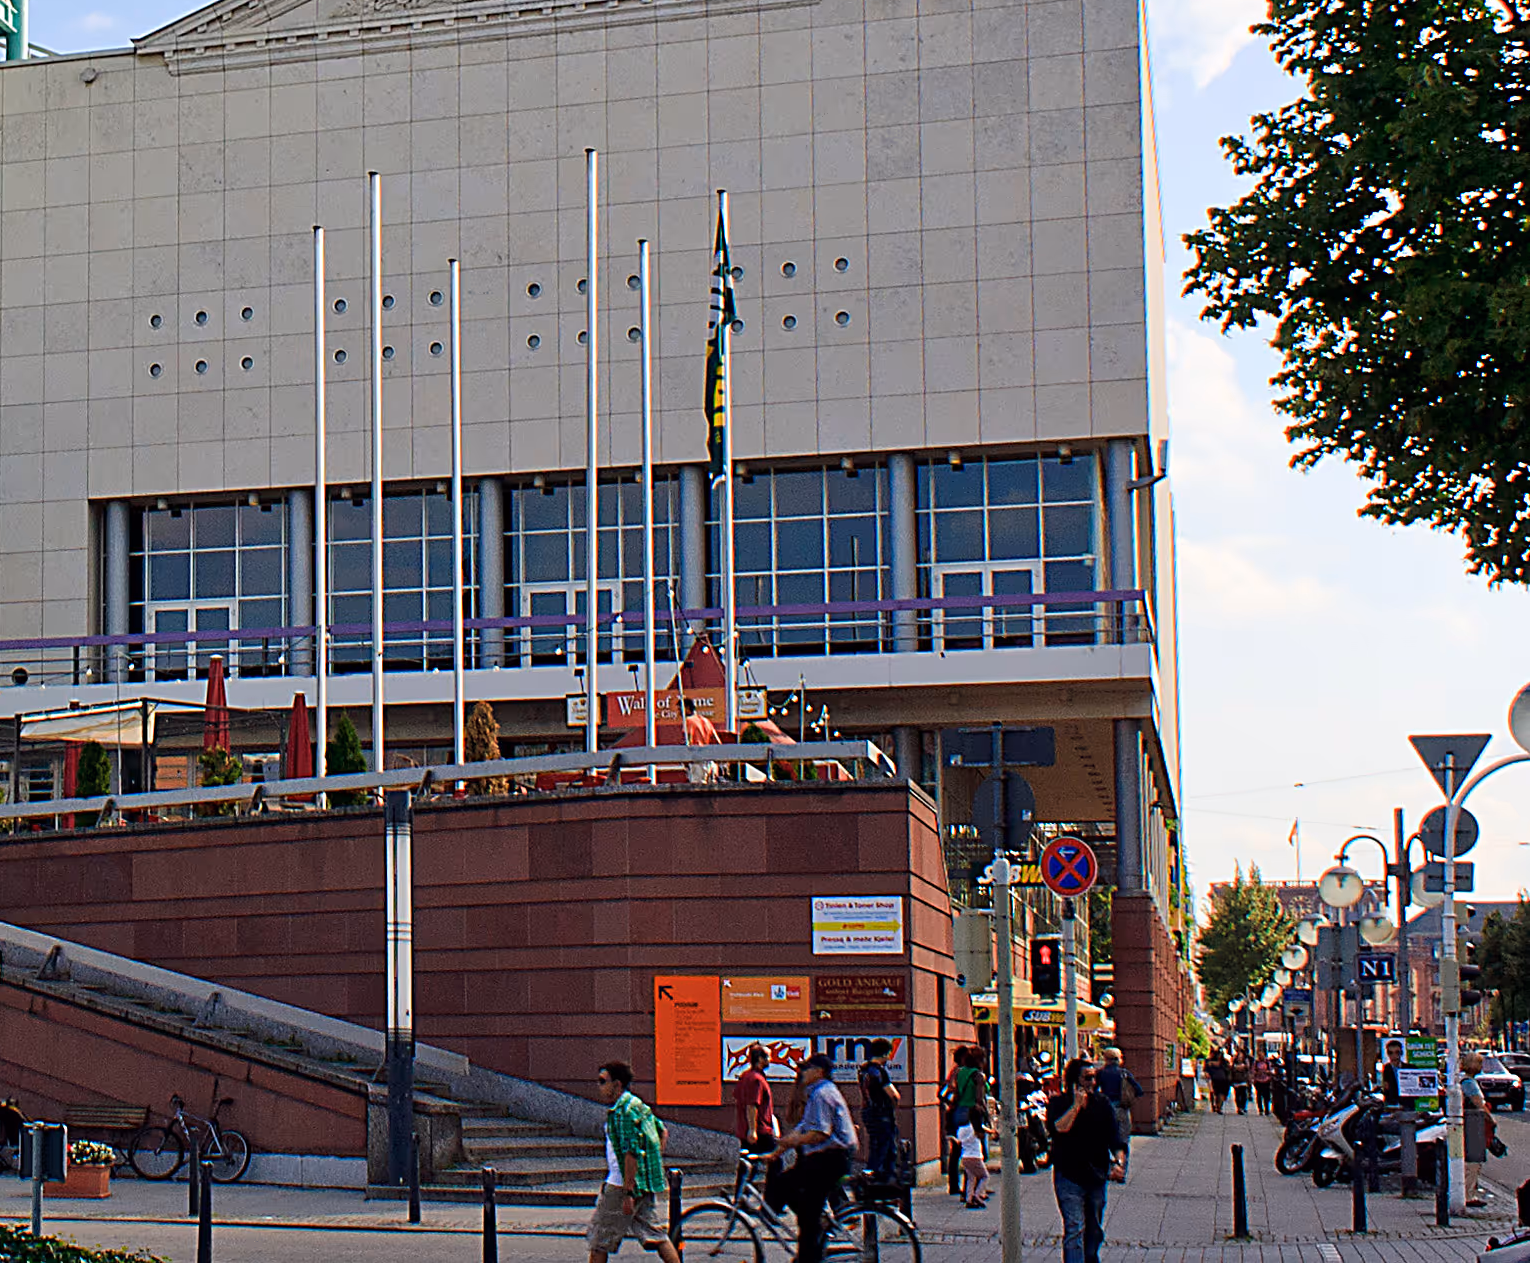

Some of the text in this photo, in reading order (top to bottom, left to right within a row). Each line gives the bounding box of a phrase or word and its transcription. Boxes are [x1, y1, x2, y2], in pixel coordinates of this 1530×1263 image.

[617, 695, 646, 717] Wal
[657, 696, 672, 709] of
[976, 864, 1043, 885] SBW
[1361, 960, 1391, 977] N1
[818, 978, 903, 987] GOLD ANKAUF
[1025, 1010, 1066, 1023] SUBWA
